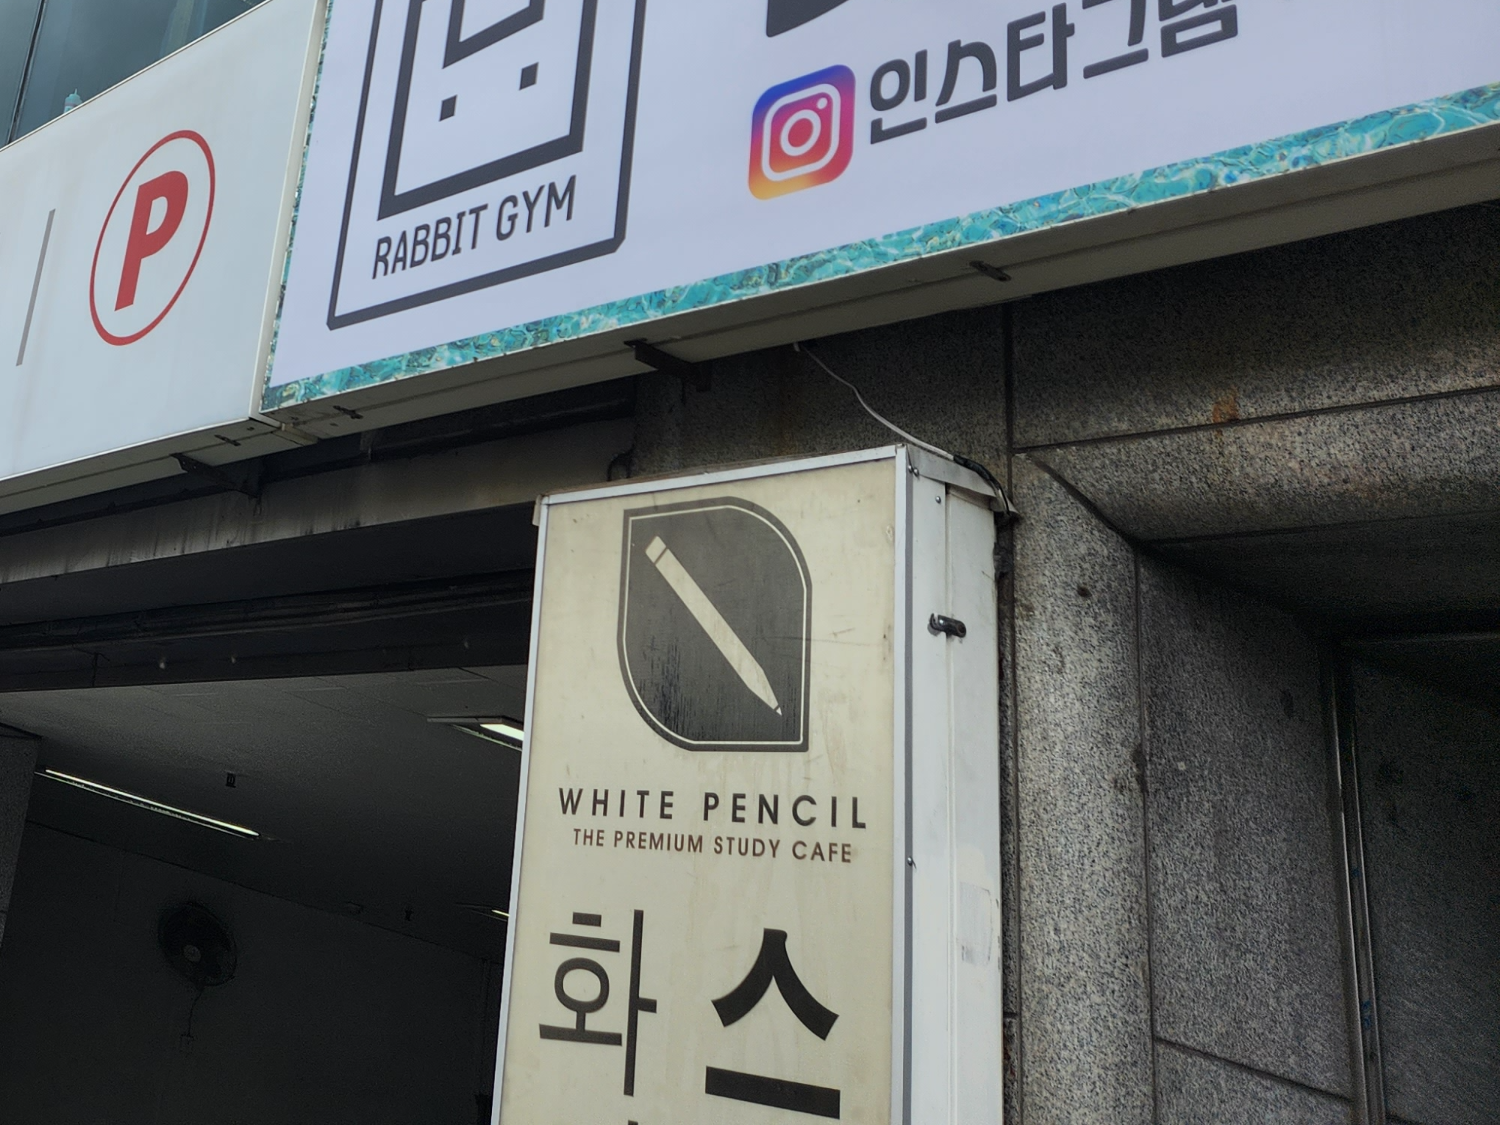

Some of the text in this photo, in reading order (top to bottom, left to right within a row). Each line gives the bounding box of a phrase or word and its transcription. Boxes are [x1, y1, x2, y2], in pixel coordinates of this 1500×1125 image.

[113, 169, 190, 312] P
[370, 173, 577, 280] RABBIT GYM
[558, 787, 867, 829] WHITE PENCIL
[573, 828, 853, 864] THE PREMIUM STUDY CAFE
[539, 909, 658, 1125] 화
[704, 927, 841, 1119] 스
